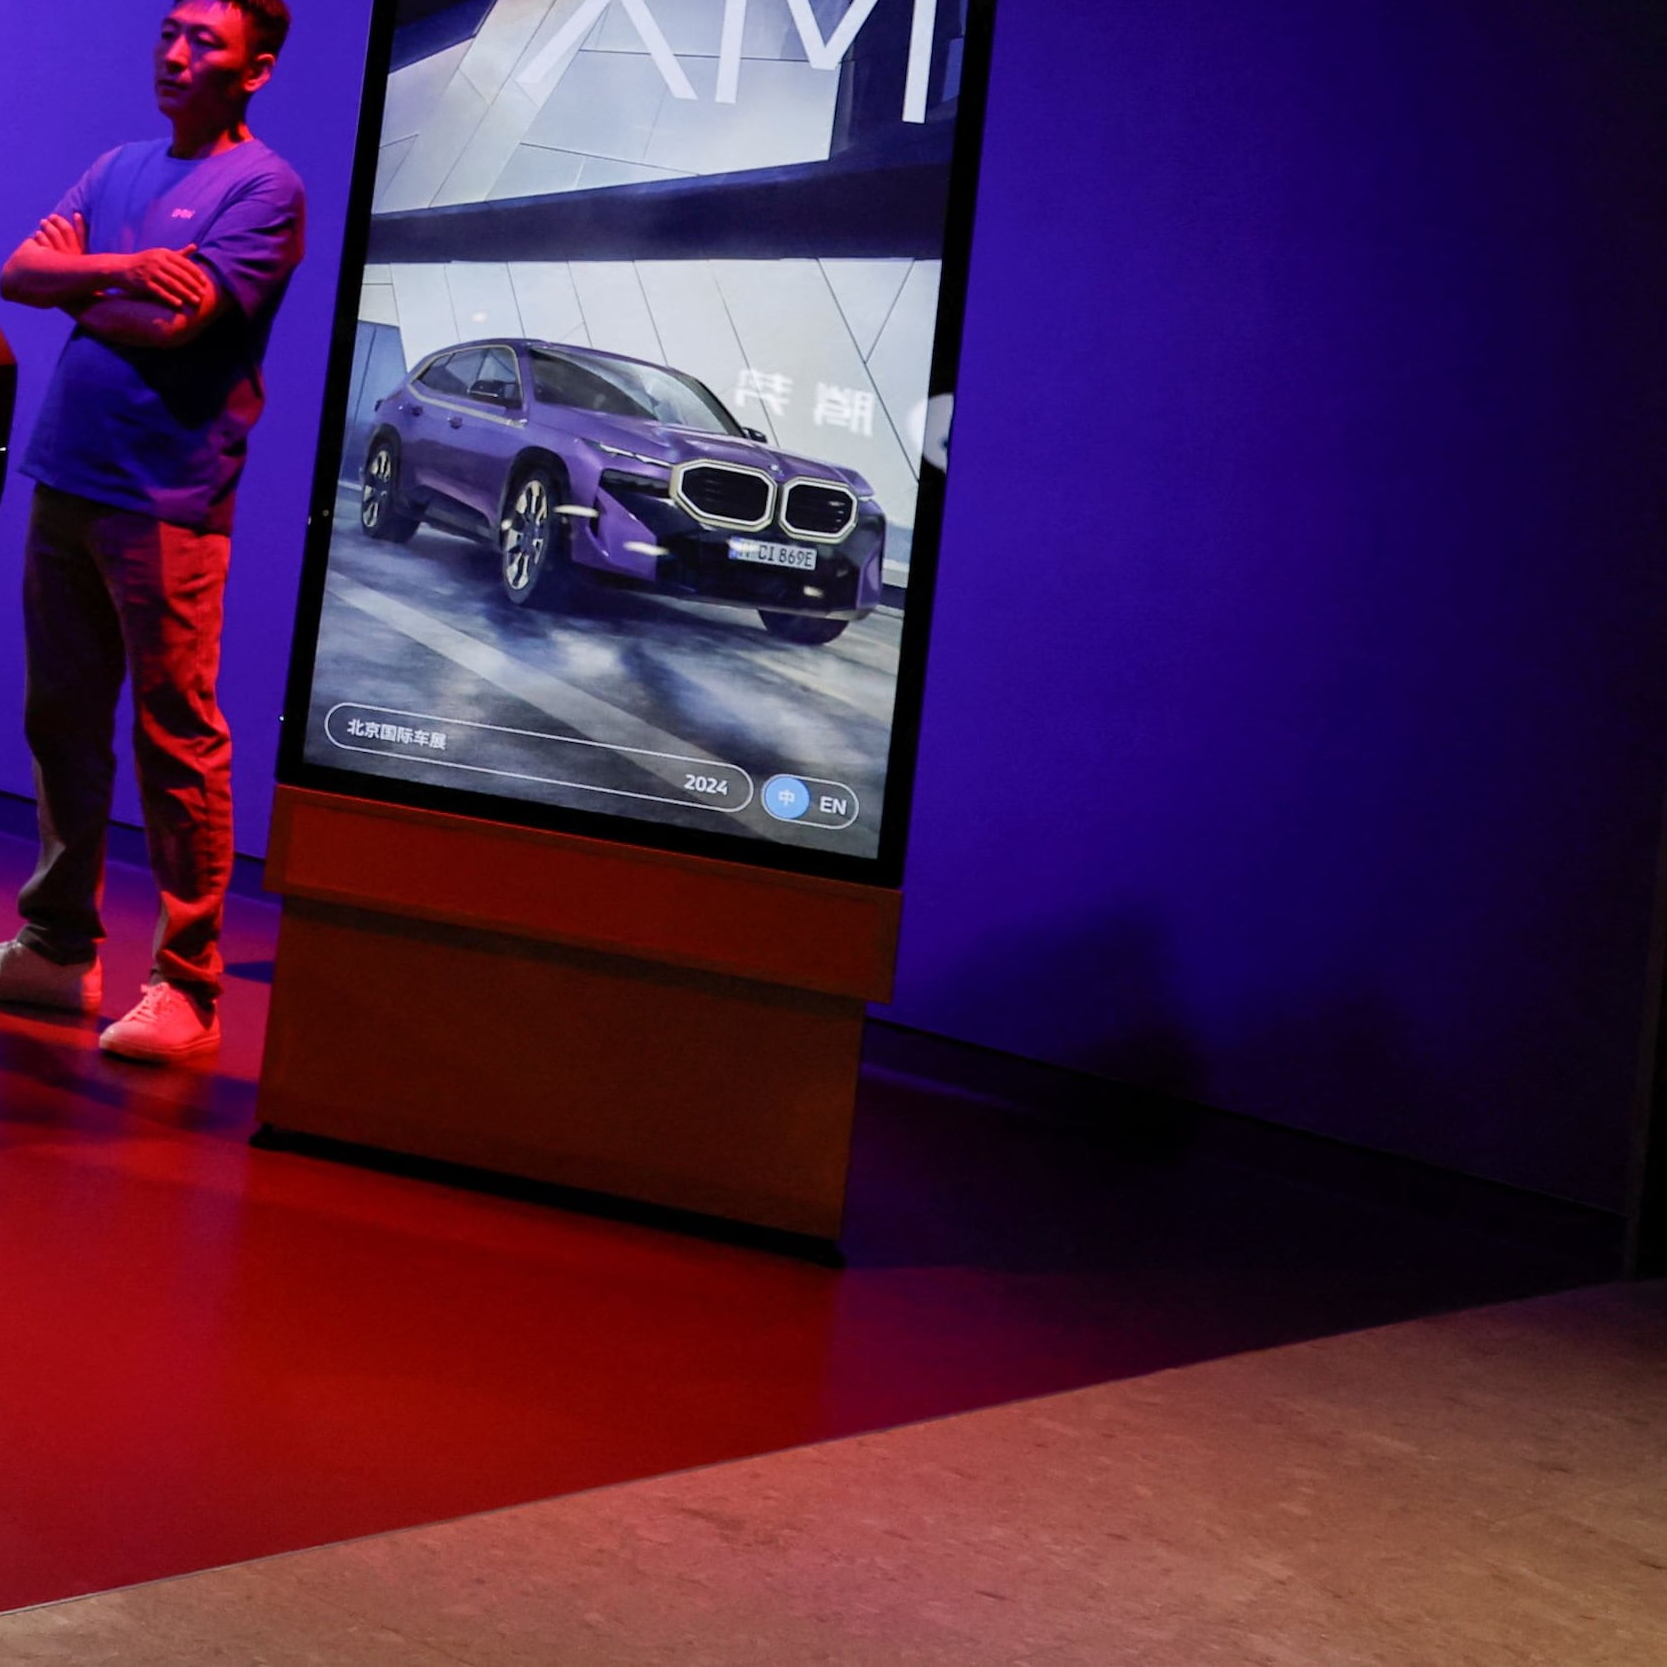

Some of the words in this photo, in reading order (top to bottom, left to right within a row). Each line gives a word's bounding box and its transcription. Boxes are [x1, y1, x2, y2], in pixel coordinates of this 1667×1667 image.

[346, 717, 447, 750] 北京国际车展
[683, 773, 728, 796] 2024
[777, 788, 797, 807] 中
[819, 795, 848, 817] EN
